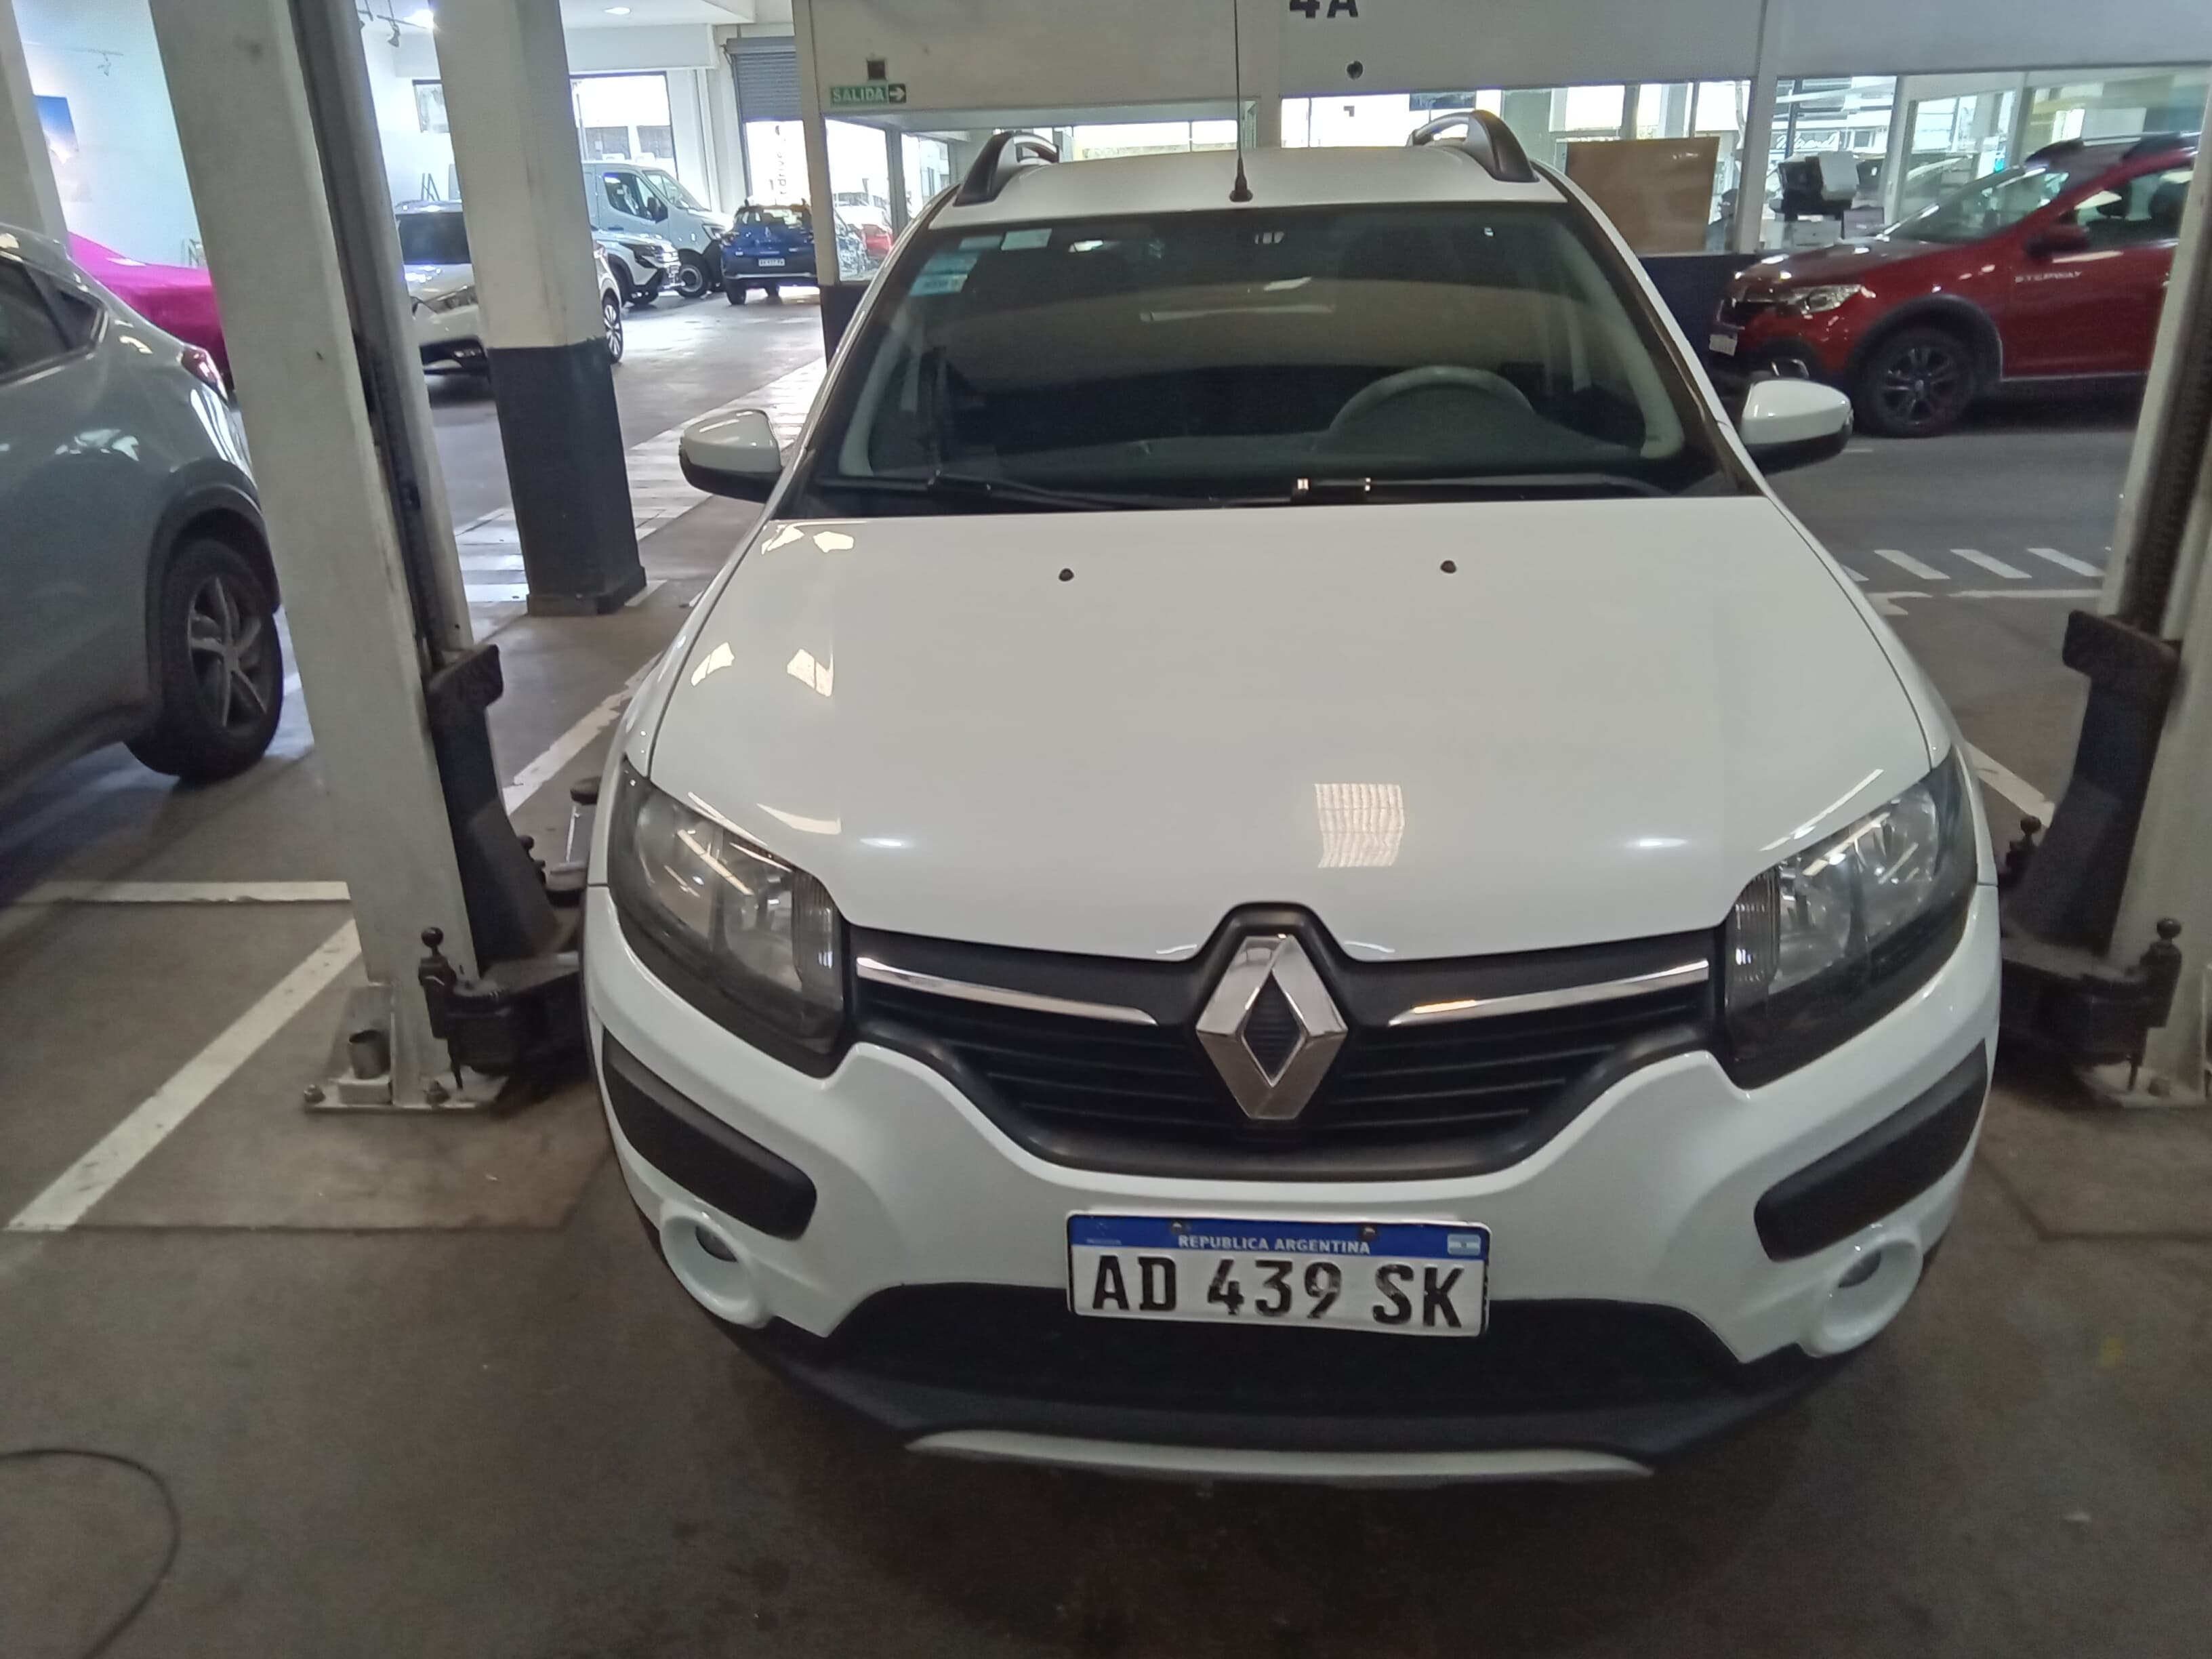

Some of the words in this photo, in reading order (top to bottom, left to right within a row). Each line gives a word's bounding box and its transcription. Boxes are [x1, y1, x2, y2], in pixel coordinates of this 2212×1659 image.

[833, 87, 884, 102] SALIDA
[1178, 1234, 1269, 1250] REPUBLICA
[1274, 1237, 1370, 1254] ARGENTINA
[1092, 1255, 1177, 1312] AD
[1208, 1258, 1342, 1319] 439
[1372, 1263, 1465, 1328] SK
